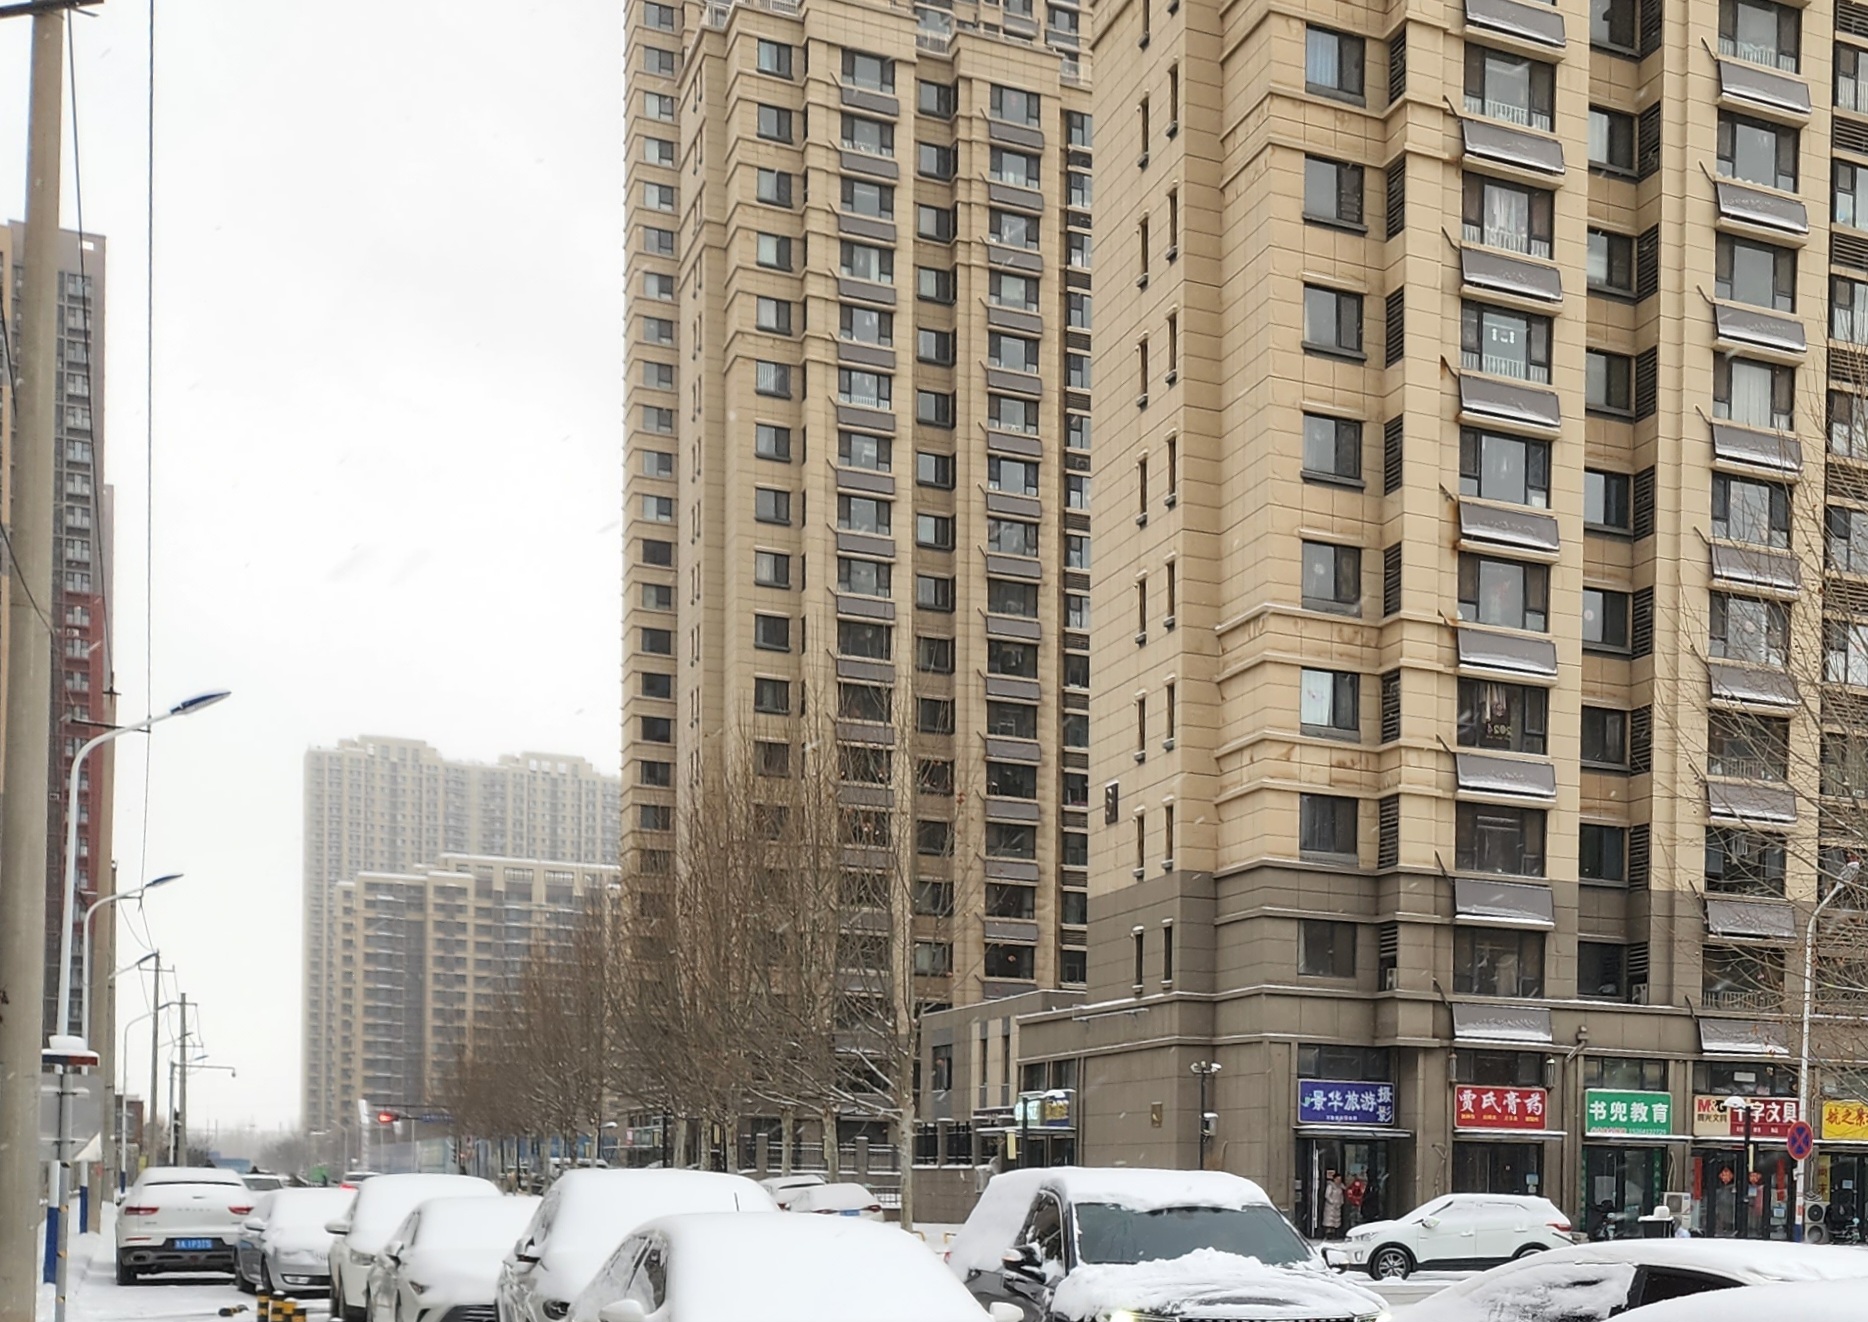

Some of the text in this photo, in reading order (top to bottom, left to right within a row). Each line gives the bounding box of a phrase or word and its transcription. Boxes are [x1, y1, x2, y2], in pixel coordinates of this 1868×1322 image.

[1310, 1089, 1377, 1112] 景华旅游
[1376, 1085, 1393, 1123] 摄影
[1458, 1089, 1543, 1116] 贾氏膏药
[1588, 1100, 1669, 1124] 书兜教育
[1697, 1098, 1727, 1113] M&G
